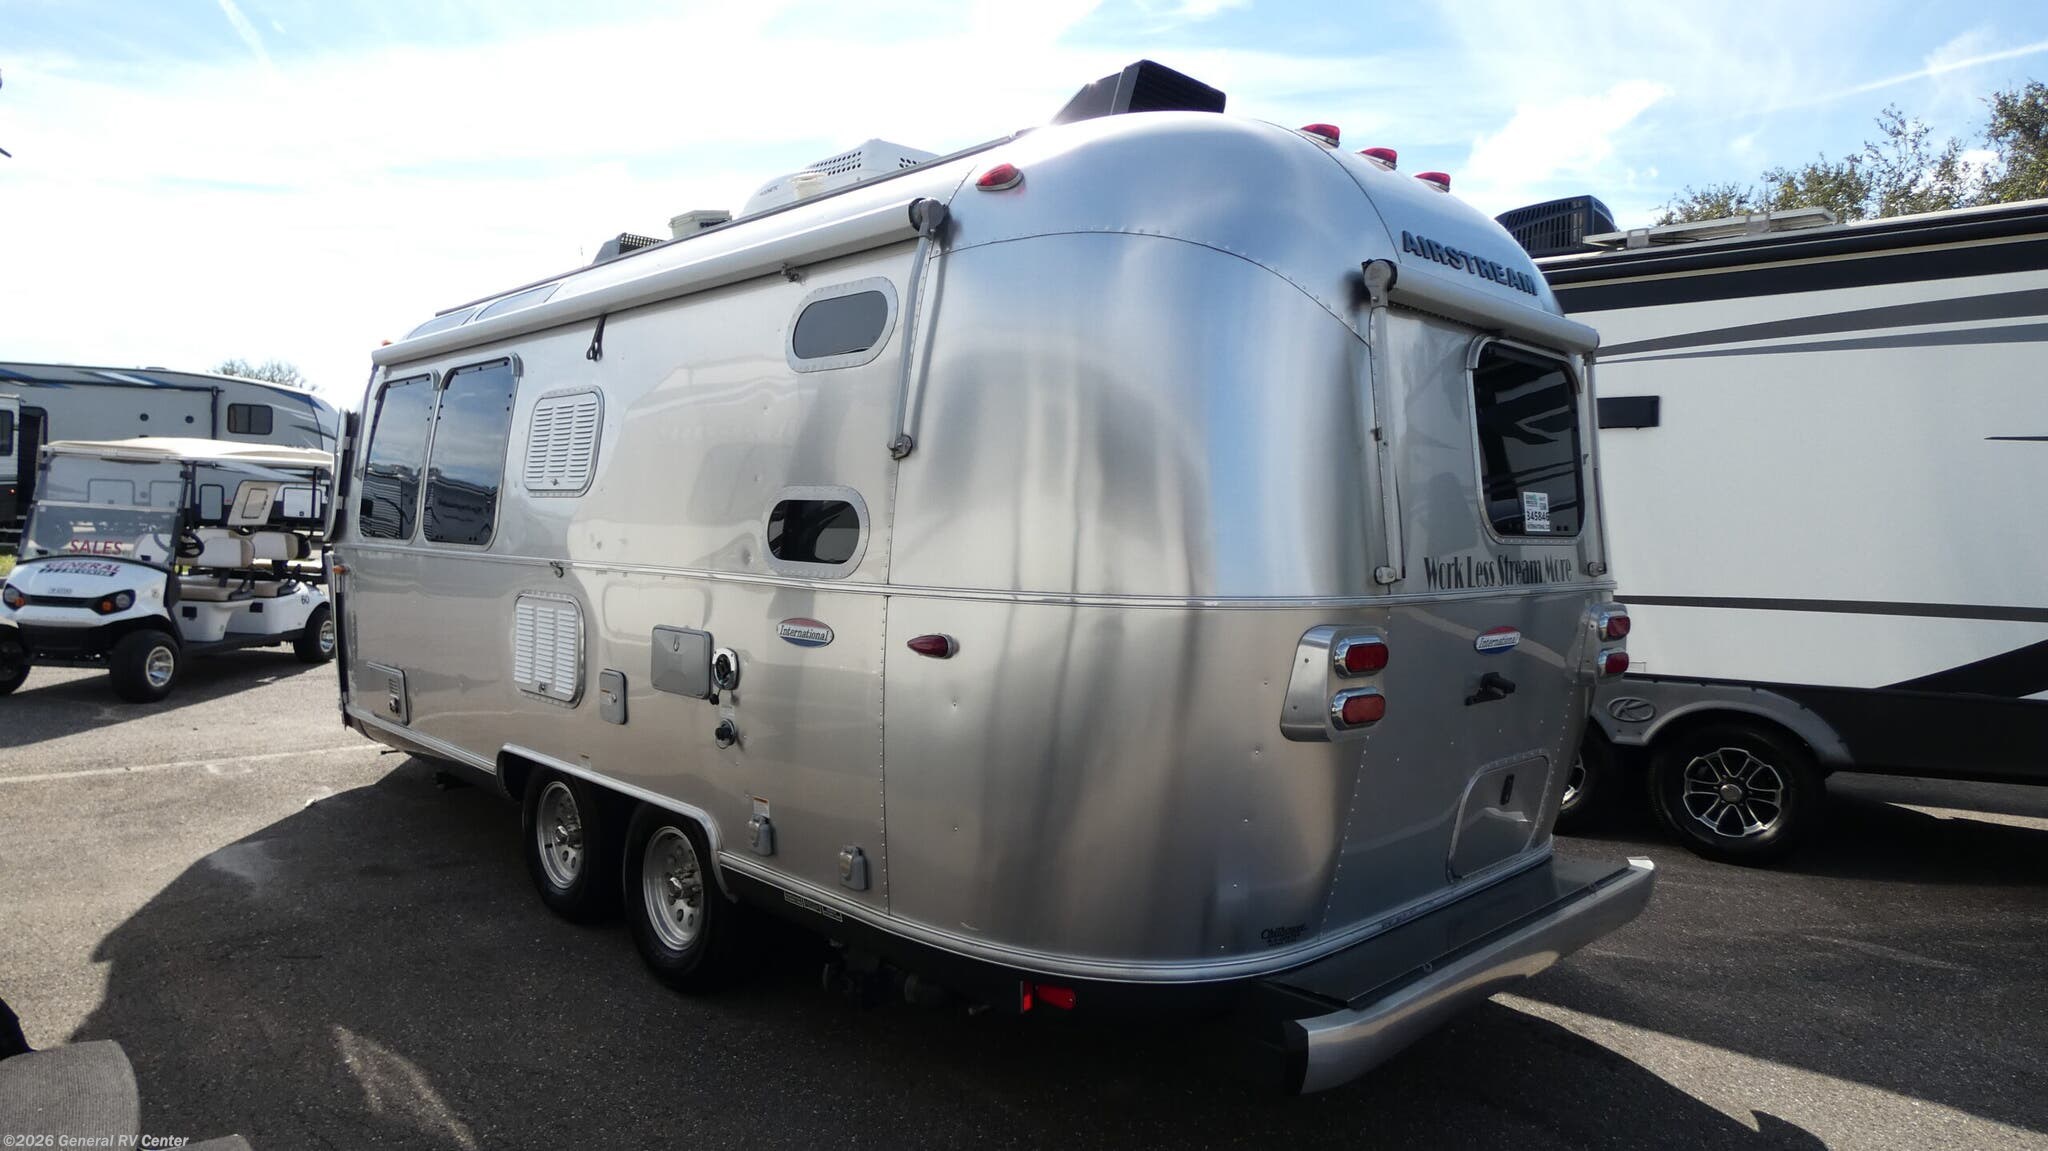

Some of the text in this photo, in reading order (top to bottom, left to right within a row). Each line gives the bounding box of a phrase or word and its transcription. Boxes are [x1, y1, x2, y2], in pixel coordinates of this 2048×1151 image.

[1401, 230, 1538, 296] AIRSTREAM
[69, 539, 123, 555] SALES
[1424, 552, 1572, 591] Work Less Stream More
[780, 624, 830, 641] International
